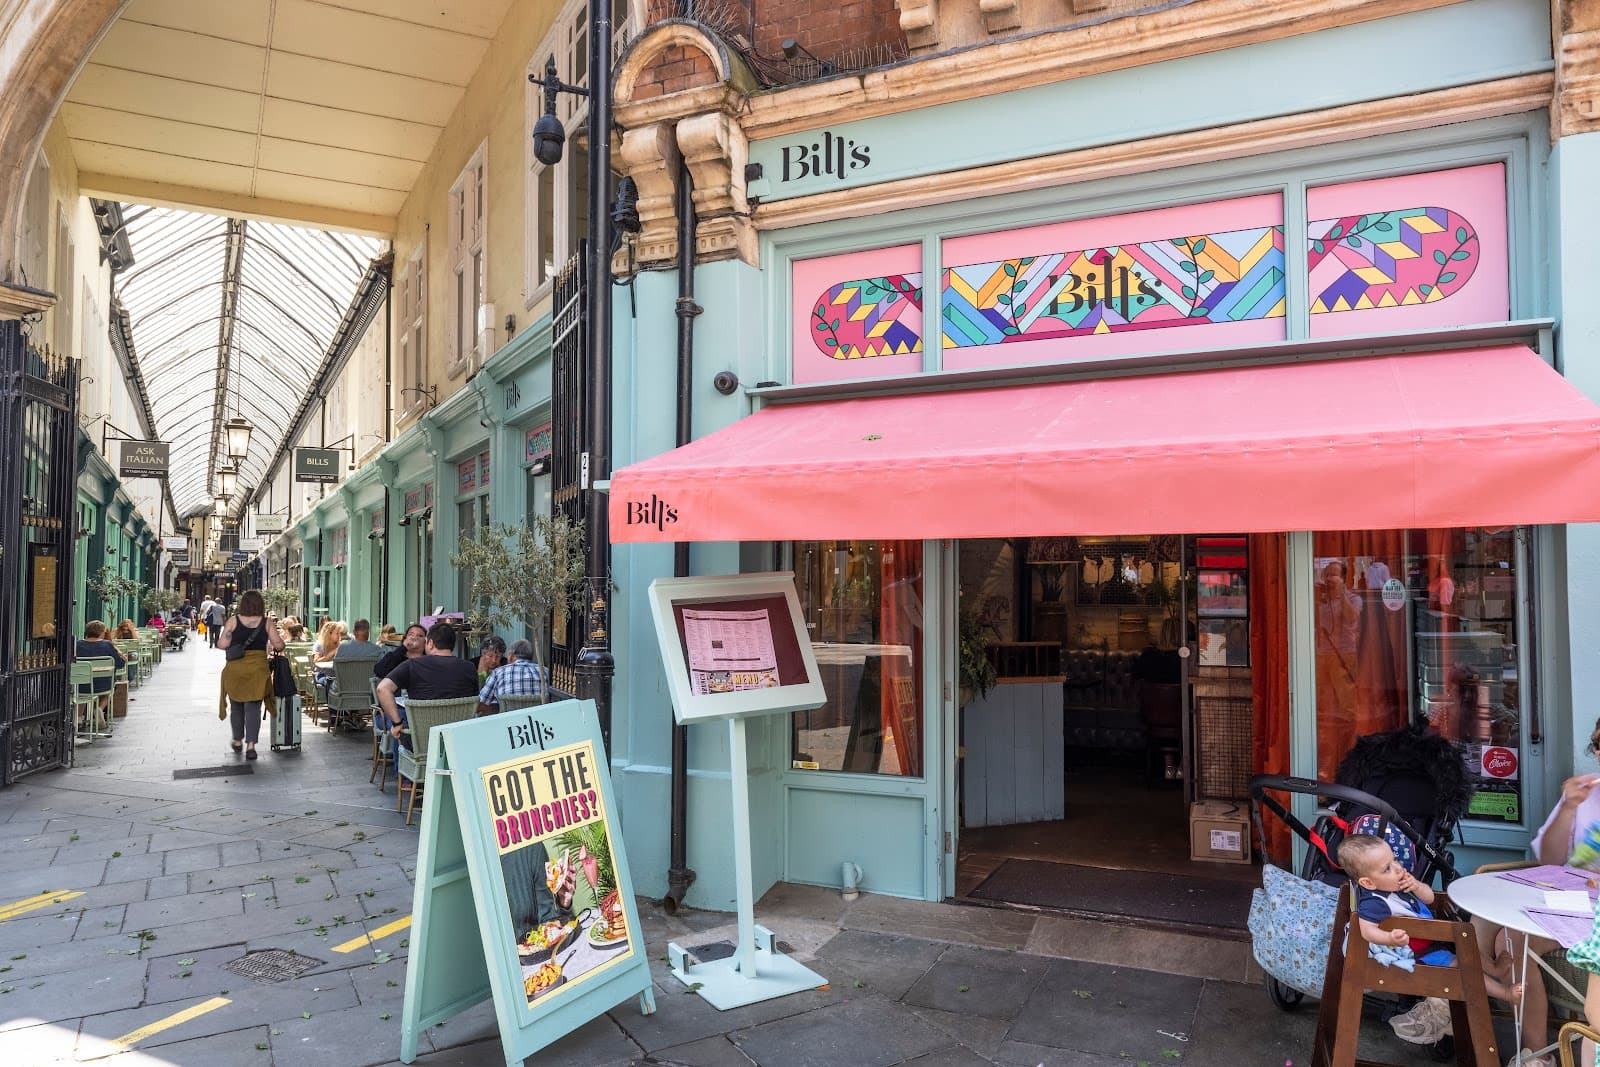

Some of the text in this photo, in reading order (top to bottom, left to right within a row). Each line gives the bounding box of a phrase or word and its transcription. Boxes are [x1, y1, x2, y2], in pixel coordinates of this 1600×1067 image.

[780, 131, 871, 182] Bill's
[1048, 256, 1163, 323] Bill's
[126, 455, 164, 465] ITALIAN
[135, 447, 156, 456] ASK
[306, 457, 329, 466] BILLS
[626, 494, 679, 532] Bill's
[507, 715, 555, 751] Bill's
[1488, 758, 1512, 769] Choice
[489, 752, 592, 817] GOT THE
[495, 789, 598, 849] BRUNCHIES?
